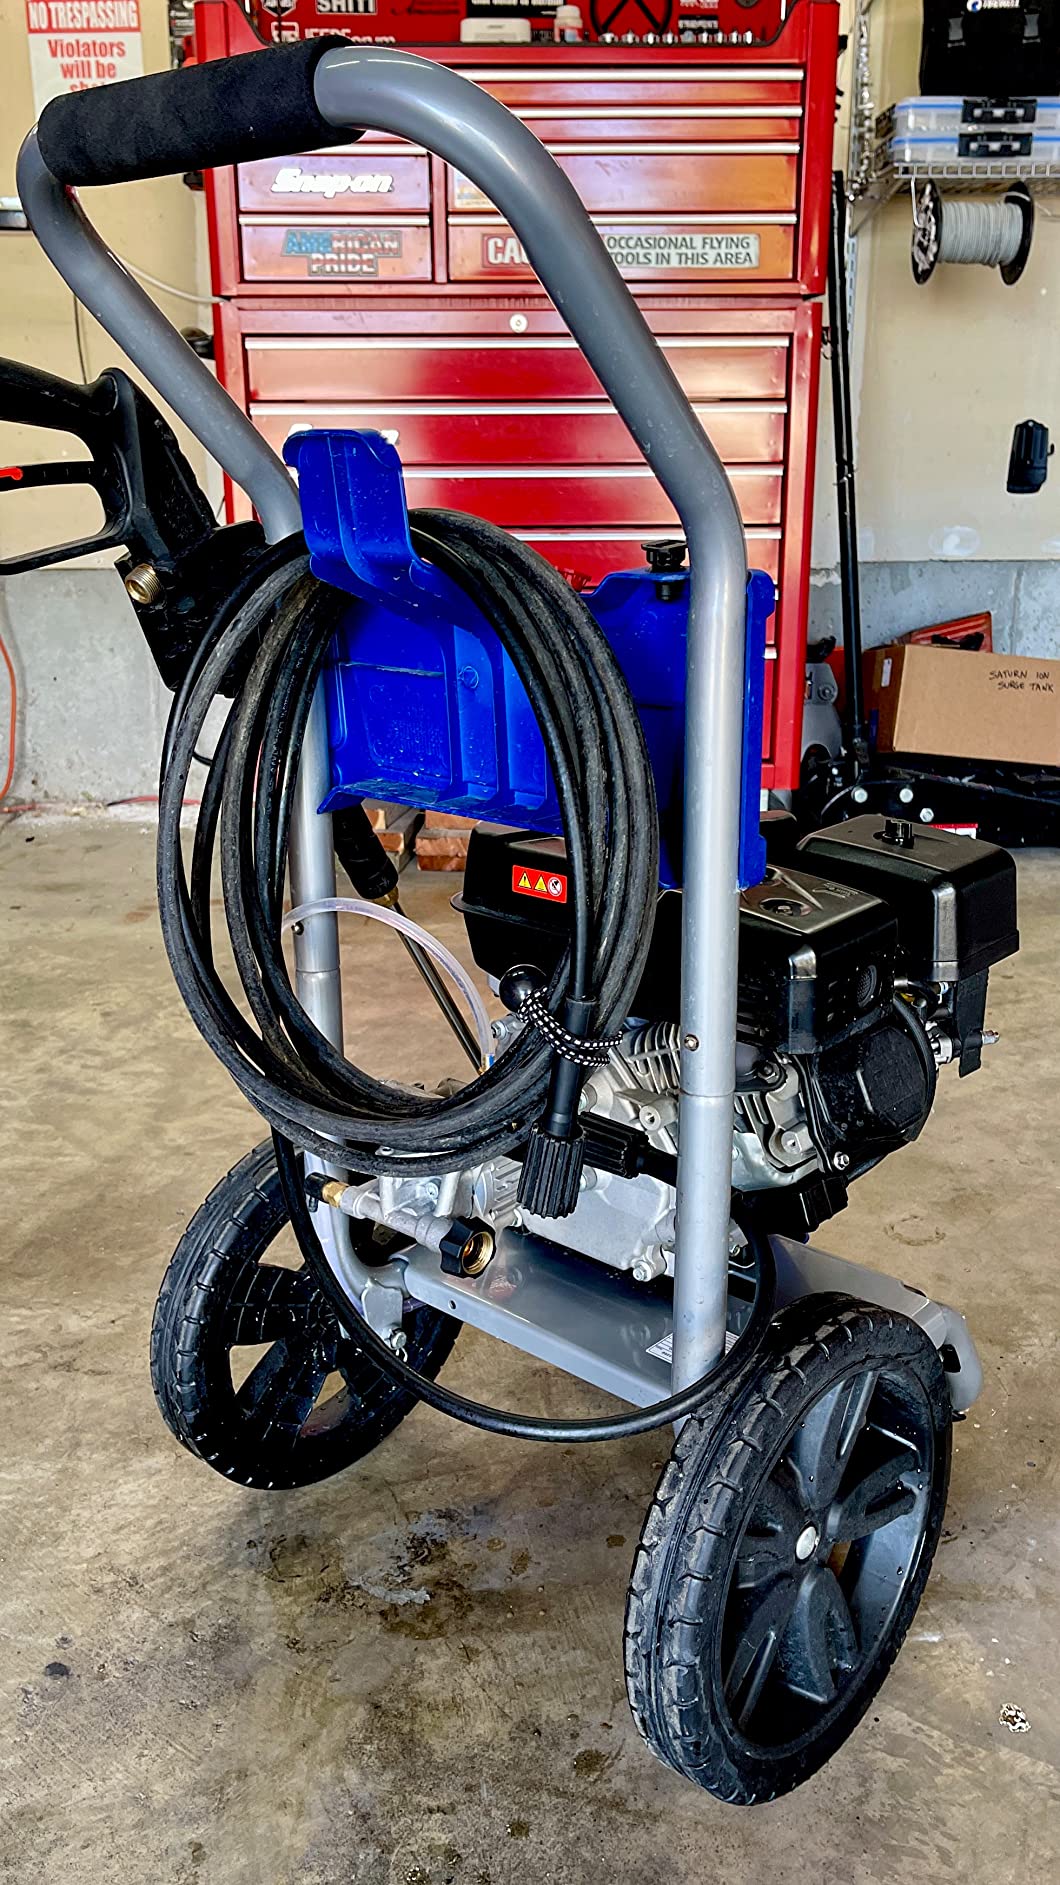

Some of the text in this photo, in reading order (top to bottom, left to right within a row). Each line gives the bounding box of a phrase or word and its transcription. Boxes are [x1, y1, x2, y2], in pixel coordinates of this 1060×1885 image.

[28, 1, 48, 29] NO
[49, 1, 139, 29] TRESPASSING
[48, 39, 126, 58] Violators
[60, 60, 116, 79] will be
[271, 168, 393, 198] Snap-on
[286, 232, 399, 254] AMERICAN
[606, 236, 750, 250] OCCASIONAL FLYING
[311, 254, 375, 273] PRIDE
[655, 252, 671, 265] IN
[677, 252, 708, 265] THIS
[713, 252, 753, 265] AREA
[988, 669, 1050, 681] SATURN ION
[1029, 682, 1054, 694] TANK
